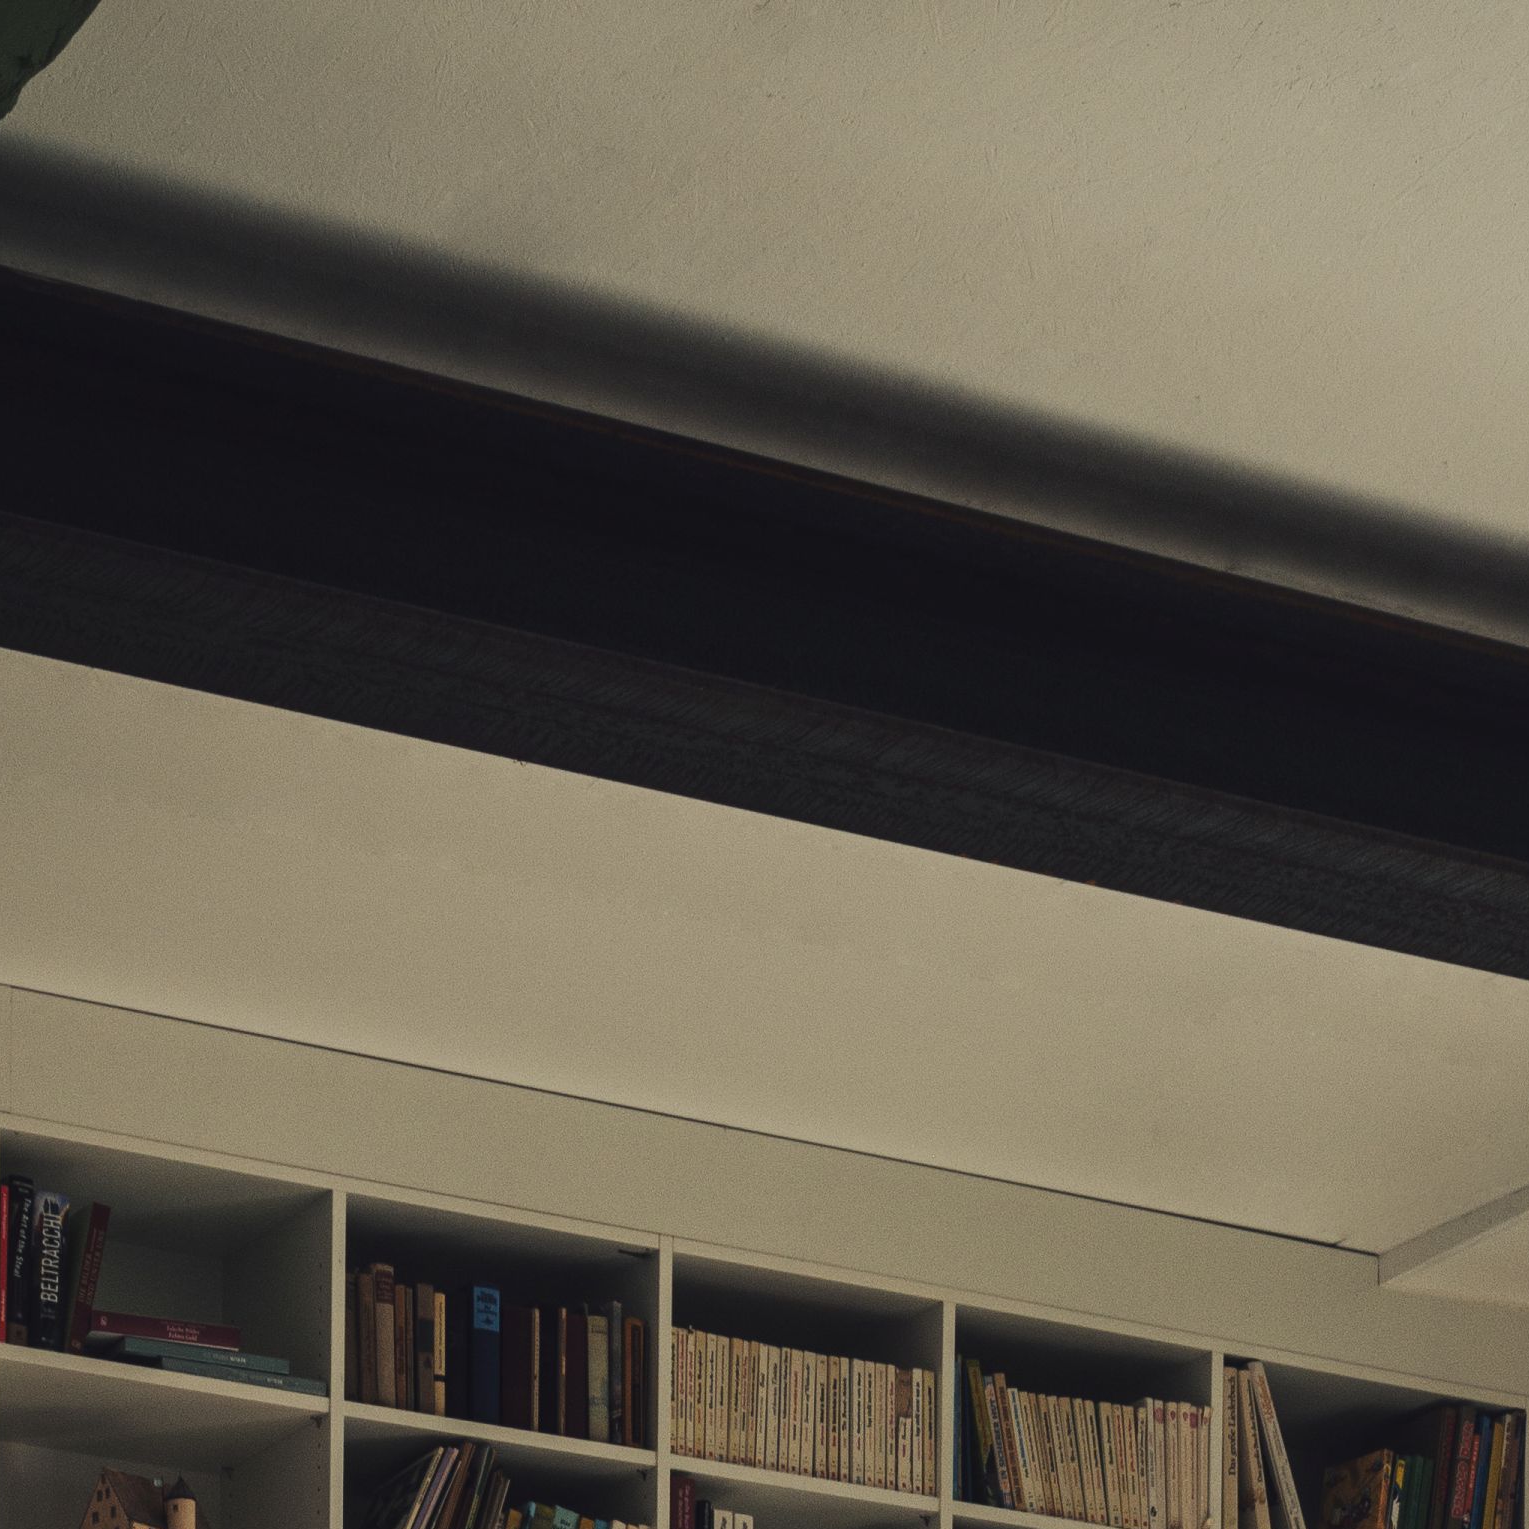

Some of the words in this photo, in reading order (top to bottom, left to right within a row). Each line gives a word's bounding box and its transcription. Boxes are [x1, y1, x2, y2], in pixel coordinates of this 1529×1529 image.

[23, 1198, 31, 1212] The
[21, 1215, 29, 1228] Art
[19, 1229, 27, 1238] of
[18, 1240, 26, 1255] the
[14, 1256, 23, 1278] Steal
